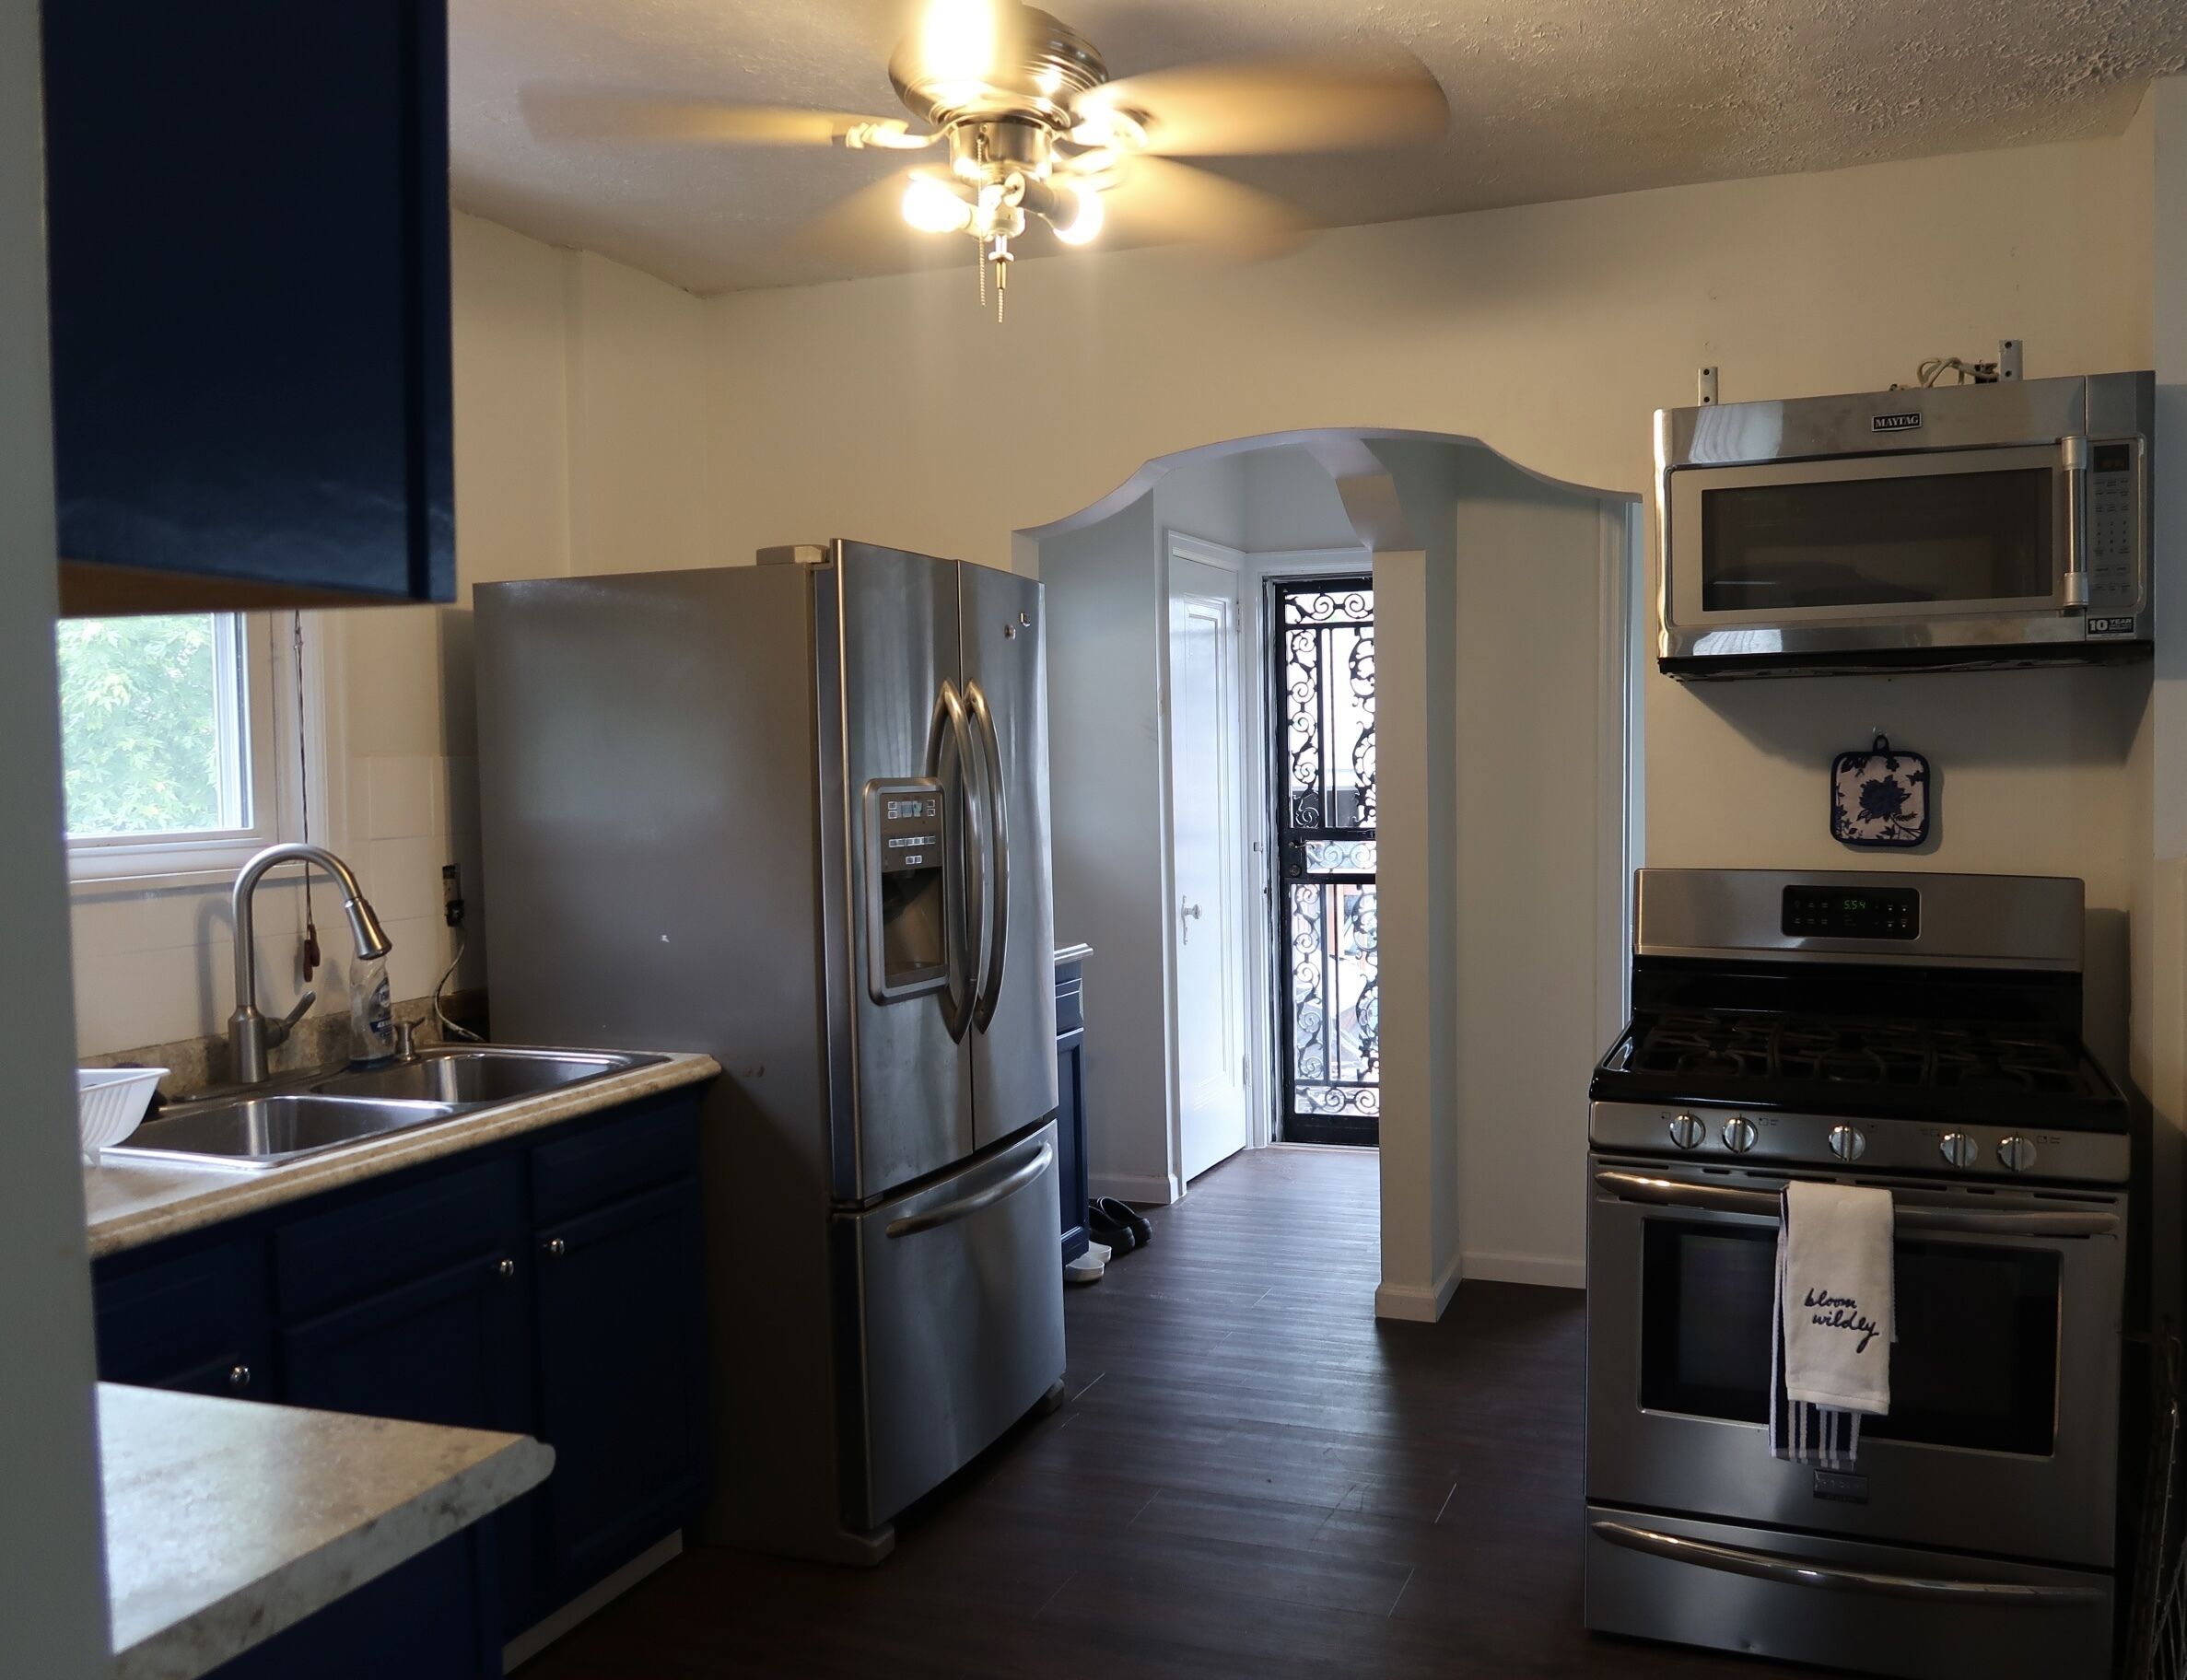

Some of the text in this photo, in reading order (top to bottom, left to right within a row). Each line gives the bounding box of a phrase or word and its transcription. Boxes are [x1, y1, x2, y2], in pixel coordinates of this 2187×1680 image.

[1875, 415, 1919, 428] MAYTAG
[2089, 619, 2109, 631] 10
[1804, 1288, 1857, 1309] bloom
[1812, 1310, 1880, 1354] wildly
